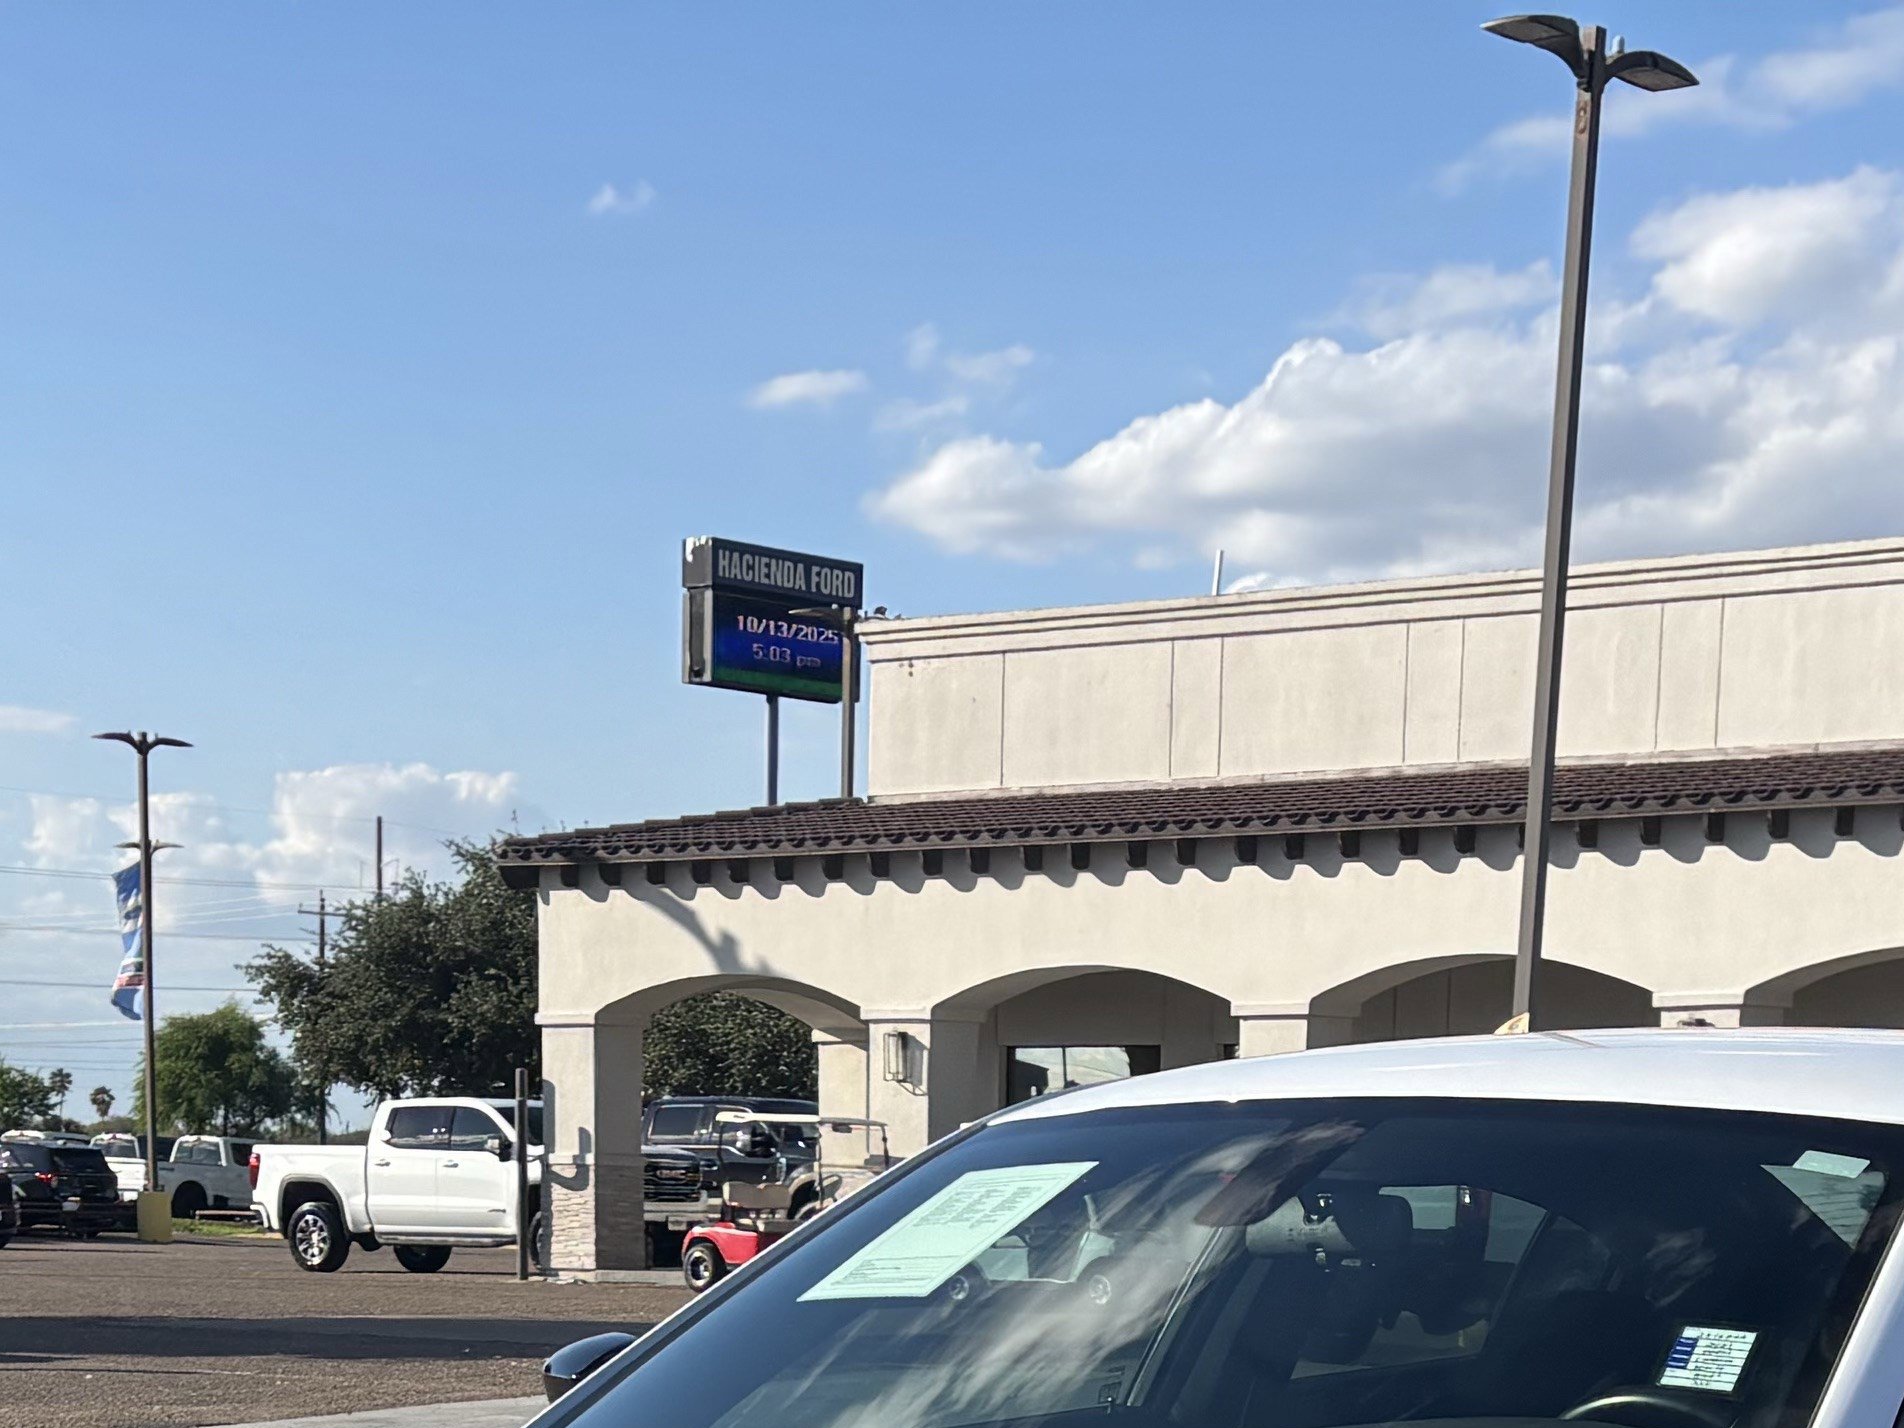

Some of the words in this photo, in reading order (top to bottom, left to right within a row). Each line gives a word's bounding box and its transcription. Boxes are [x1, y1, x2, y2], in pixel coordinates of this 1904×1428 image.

[718, 550, 806, 591] HACIENDA
[810, 565, 856, 598] FORD
[737, 615, 839, 645] 10/13/2025
